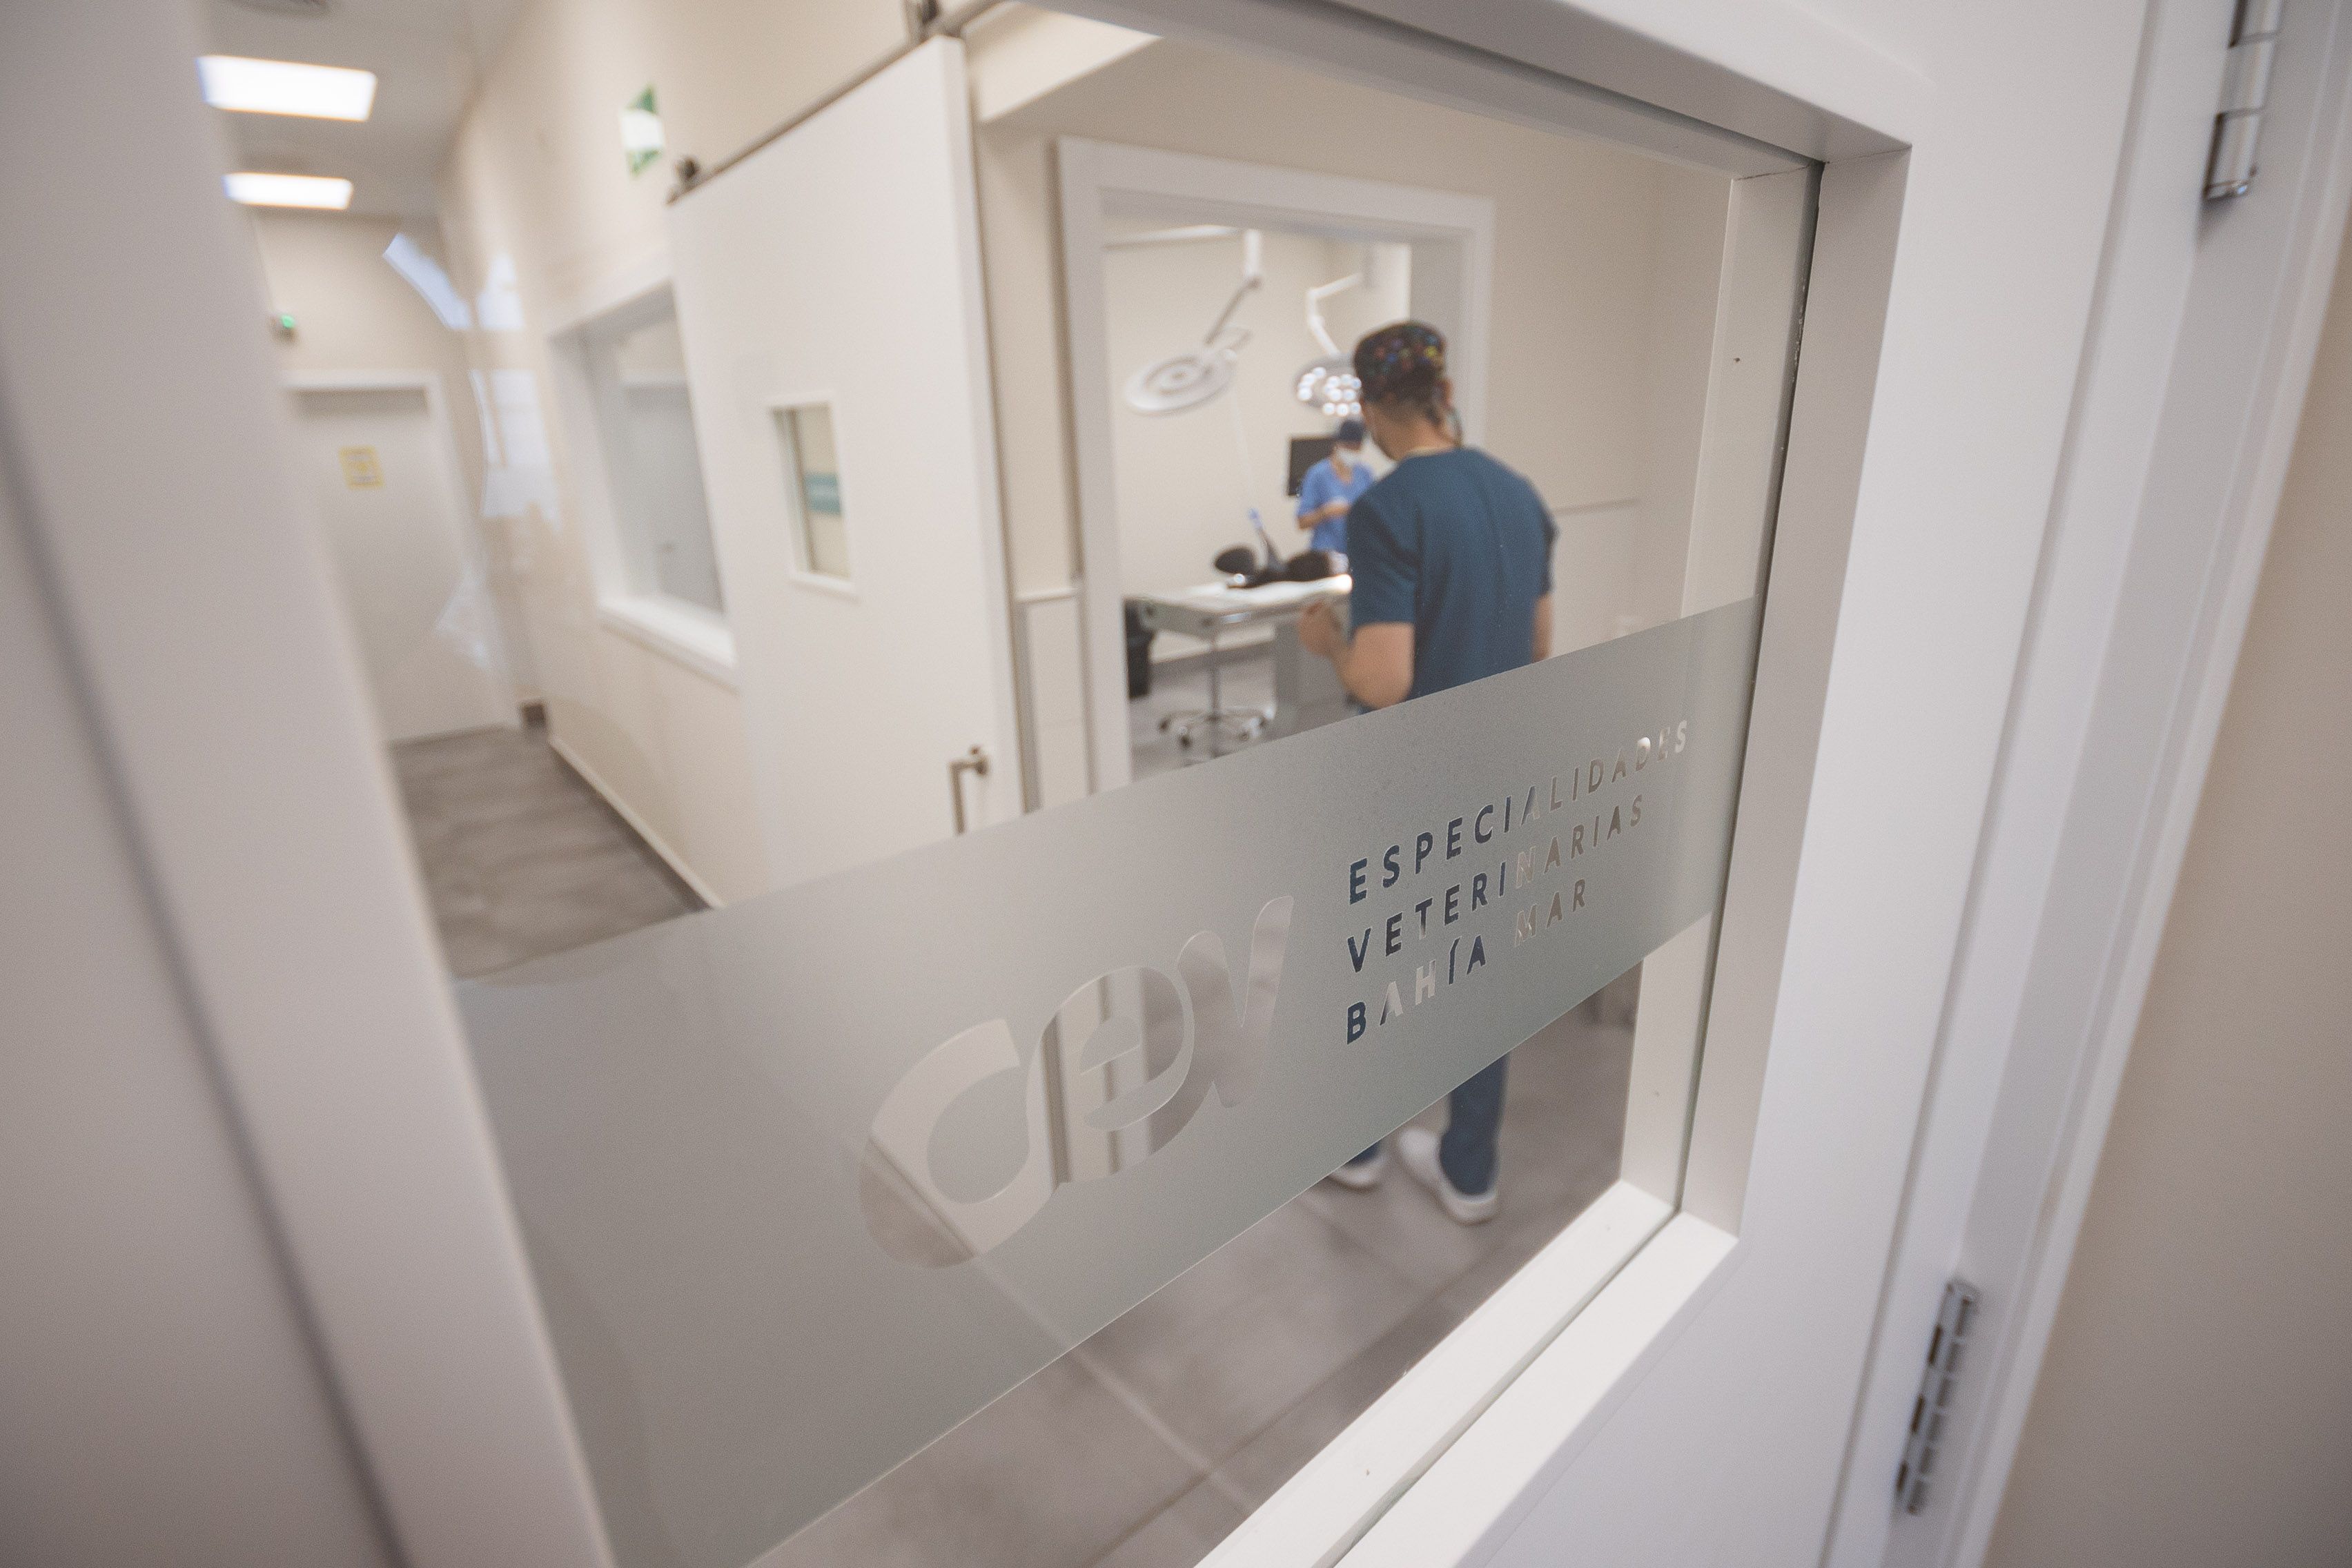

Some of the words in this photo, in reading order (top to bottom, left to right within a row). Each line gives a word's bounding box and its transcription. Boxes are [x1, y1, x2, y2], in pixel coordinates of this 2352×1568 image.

[1346, 794, 1643, 974] VETERINARIAS
[1349, 720, 1687, 905] ESPECIALIDADES
[1346, 934, 1487, 1045] BAHÍA
[1514, 878, 1587, 948] MAR
